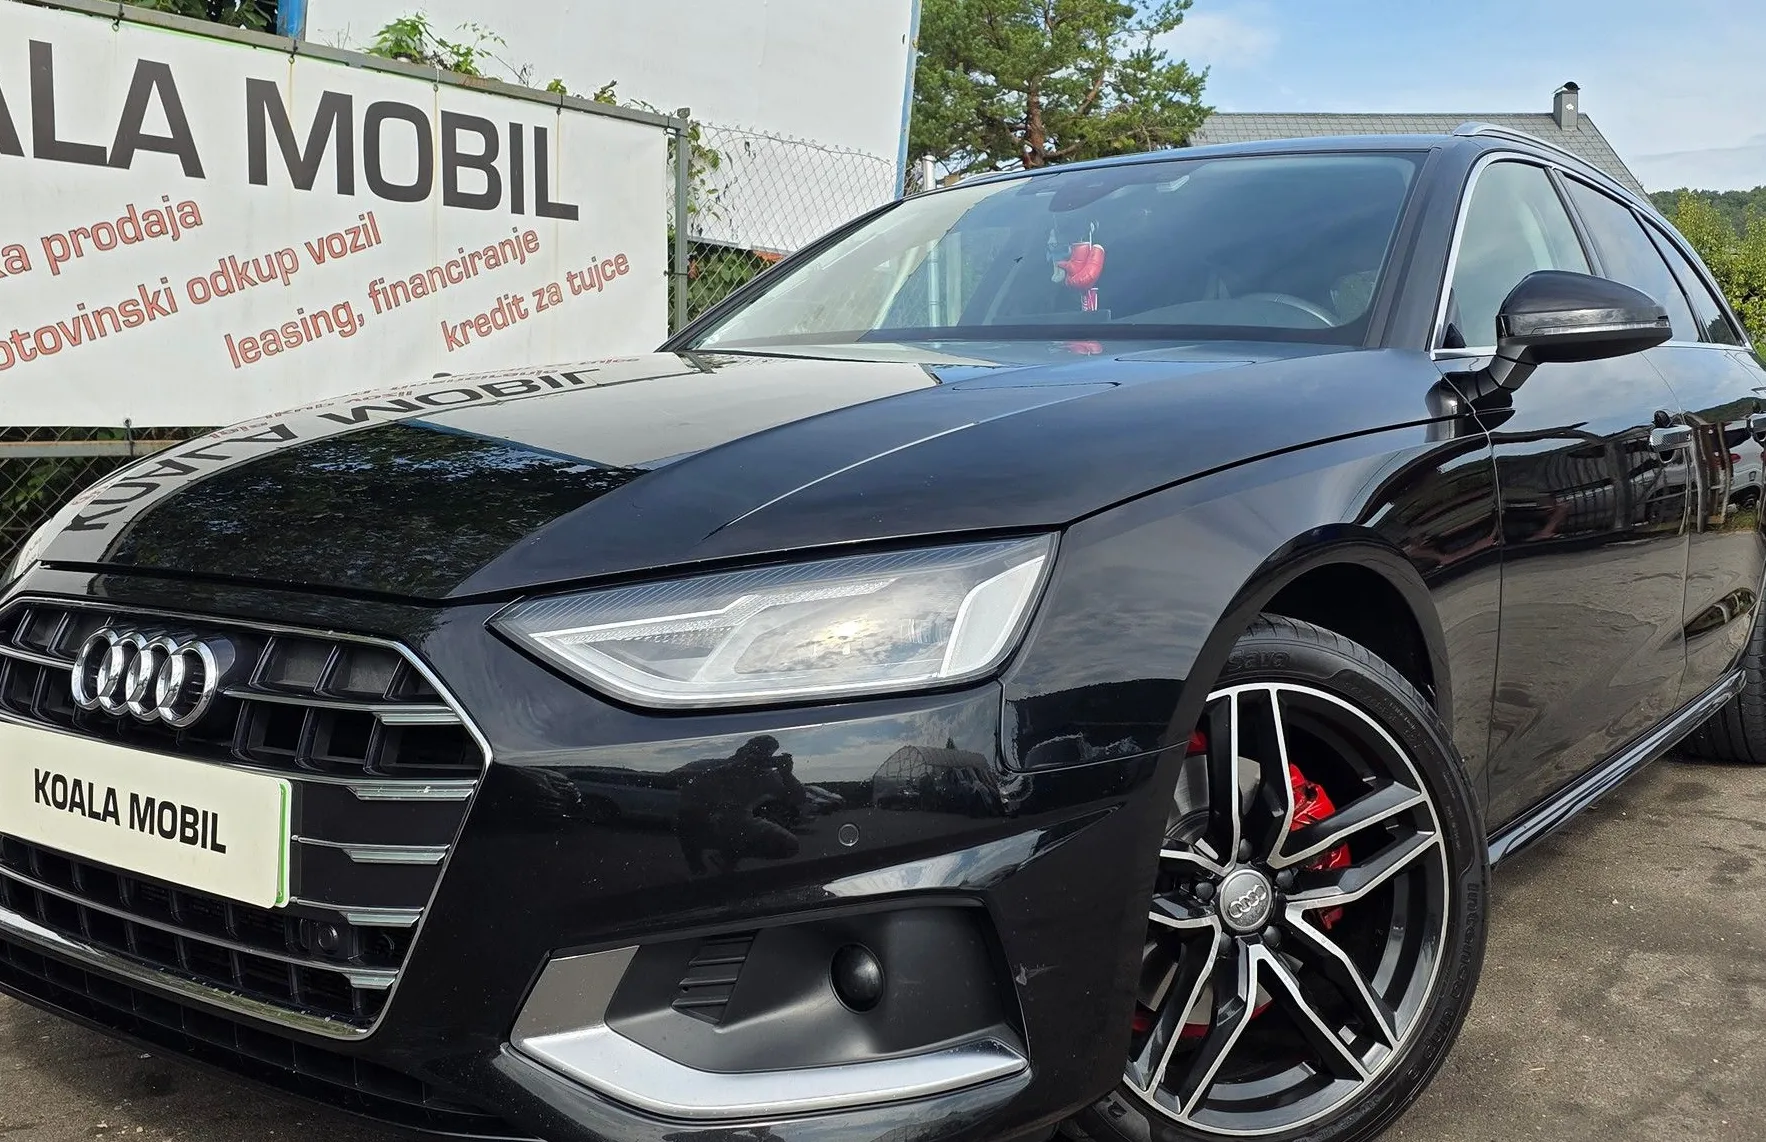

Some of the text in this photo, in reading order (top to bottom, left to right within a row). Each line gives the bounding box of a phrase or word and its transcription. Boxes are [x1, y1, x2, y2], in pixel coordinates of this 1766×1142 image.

[247, 78, 578, 221] MOBIL
[0, 195, 203, 279] a prodaja
[186, 255, 299, 305] odkup
[306, 212, 381, 267] vozil
[225, 227, 540, 369] leasing, financiranje
[441, 251, 630, 352] kredit za tujce
[35, 768, 227, 855] KOALA MOBIL
